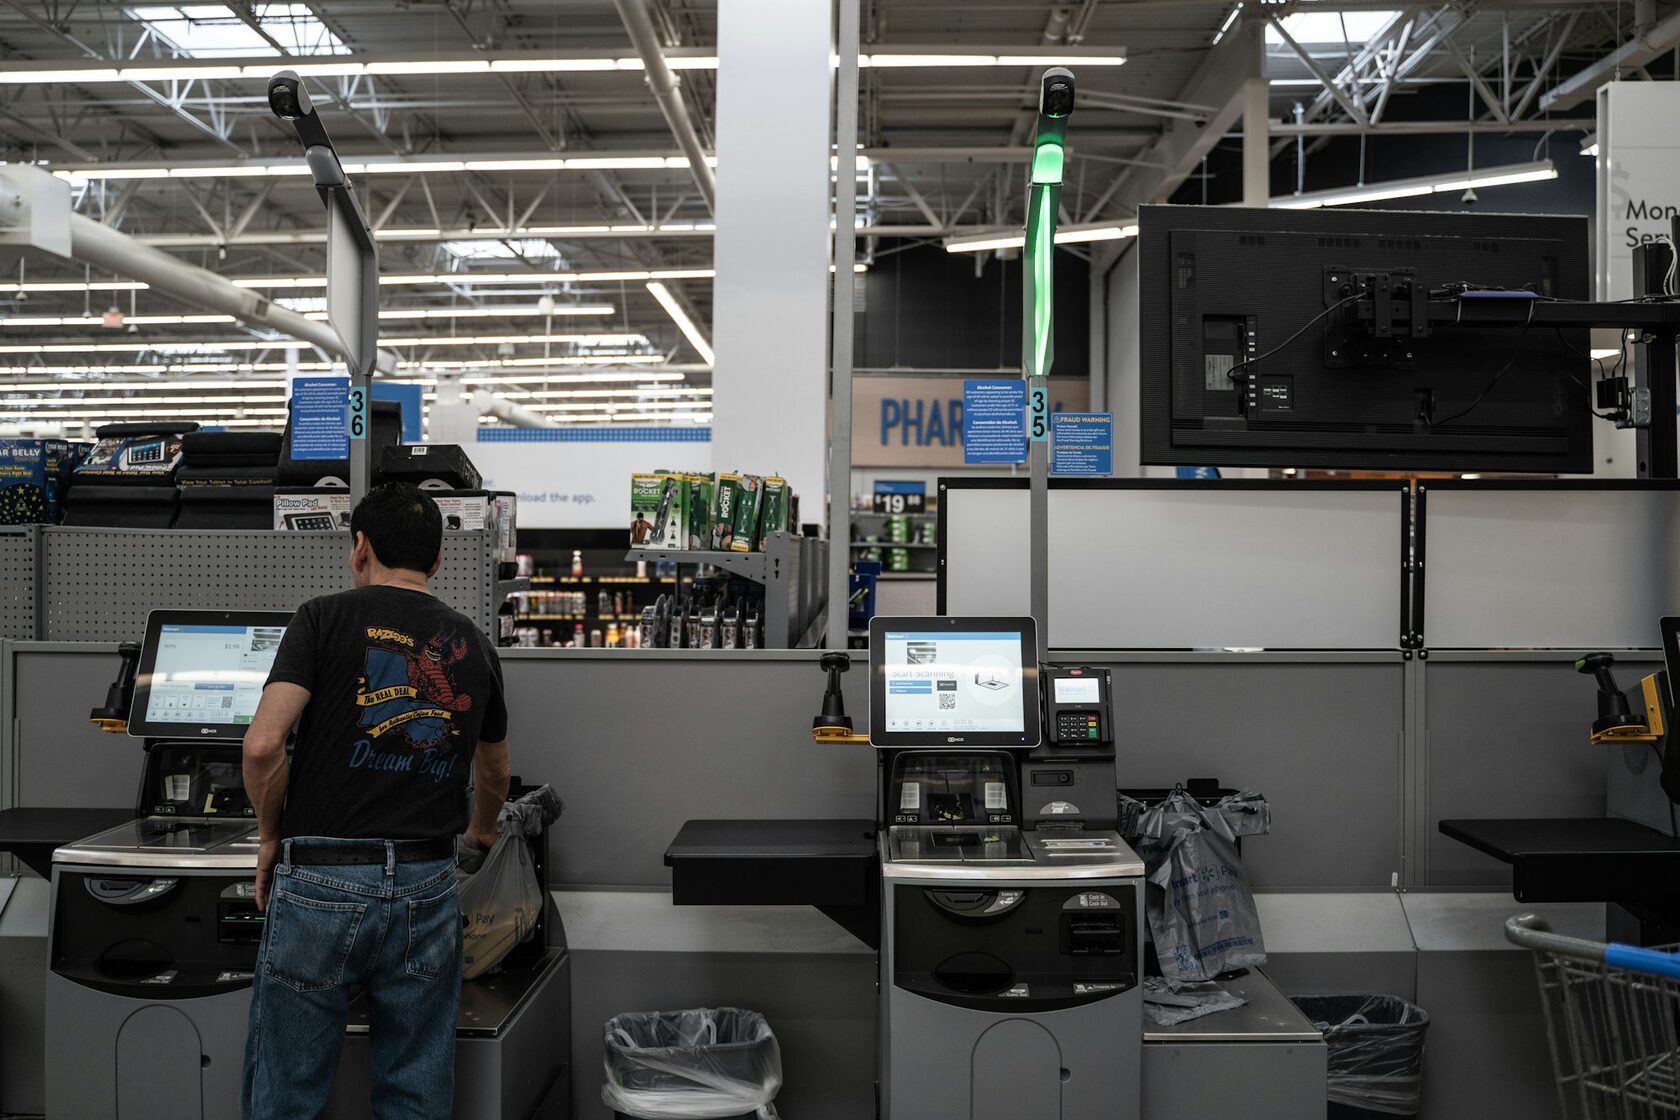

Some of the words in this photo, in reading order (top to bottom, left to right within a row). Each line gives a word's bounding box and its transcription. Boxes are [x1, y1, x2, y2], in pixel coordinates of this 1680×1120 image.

[1626, 199, 1680, 220] Mon
[12, 449, 40, 457] BELLY
[633, 487, 661, 495] ROCKET
[276, 499, 301, 508] Pillow
[302, 499, 319, 508] Pad
[517, 492, 547, 503] nload
[550, 492, 568, 503] the
[571, 494, 595, 505] app.
[721, 486, 732, 518] ROCKET
[366, 627, 416, 647] RAZZOO'S
[364, 692, 375, 703] The
[375, 690, 393, 701] REAL
[394, 687, 410, 697] DEAL
[349, 739, 415, 772] Dream
[419, 749, 459, 783] Big!
[477, 913, 495, 926] Pay
